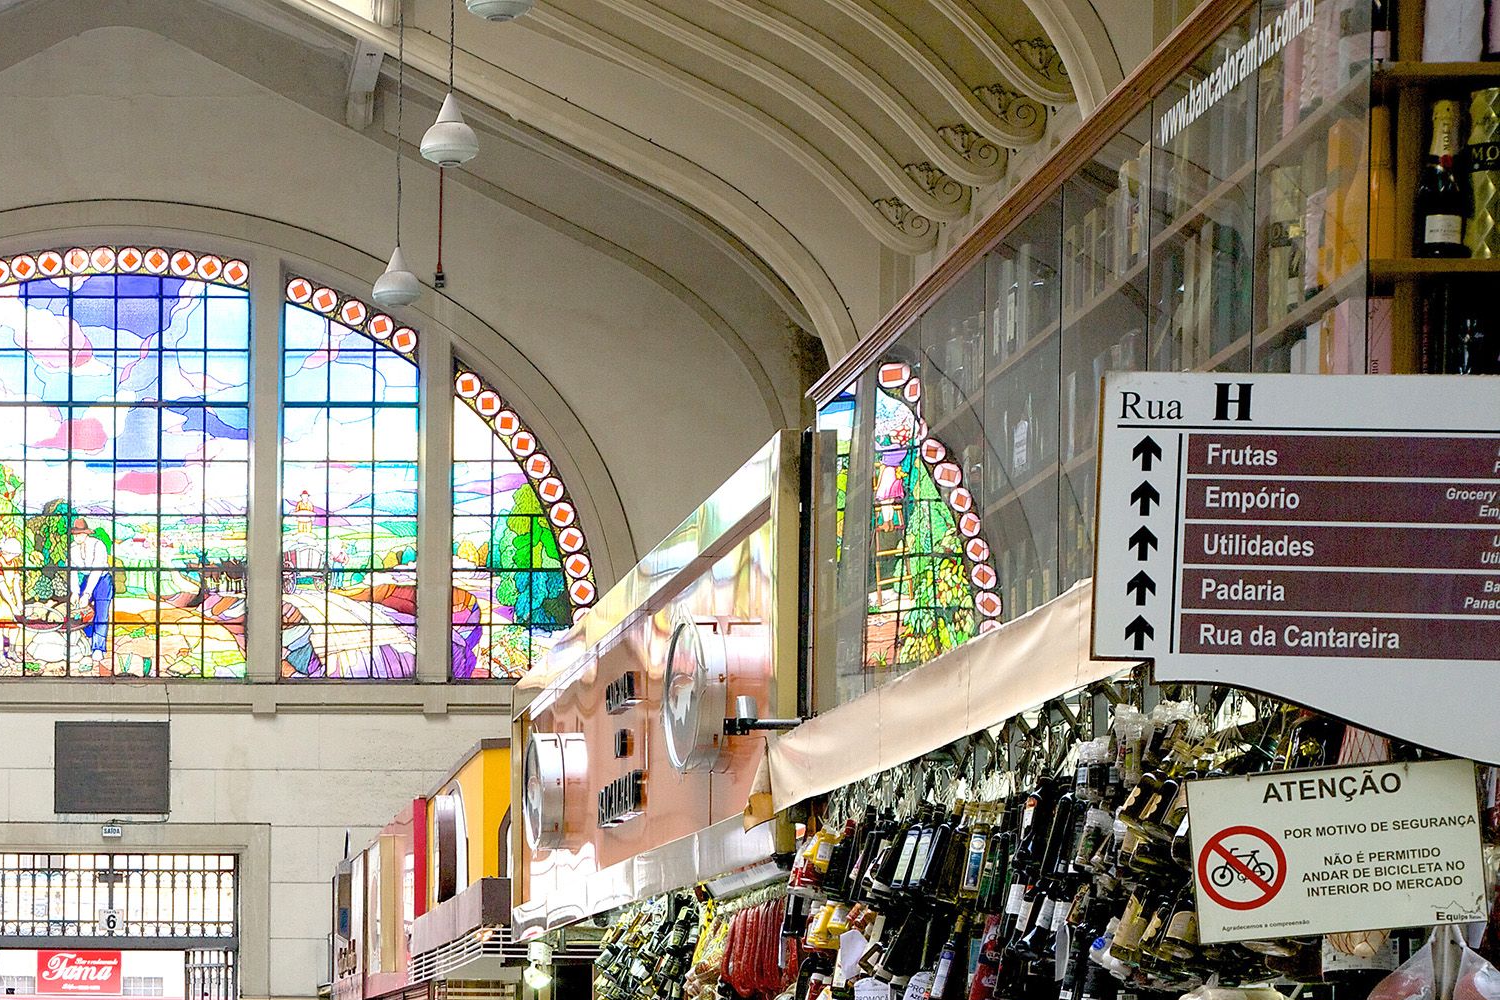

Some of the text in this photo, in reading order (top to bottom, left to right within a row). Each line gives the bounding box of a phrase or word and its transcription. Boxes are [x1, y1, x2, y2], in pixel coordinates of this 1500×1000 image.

[1119, 383, 1254, 421] Rua H
[1207, 444, 1278, 466] Frutas
[1205, 486, 1300, 512] Empório
[1446, 488, 1496, 502] Grocery
[1203, 534, 1315, 557] Utilidades
[1201, 579, 1285, 602] Padaria
[1199, 623, 1400, 649] Rua da Cantareira
[1262, 770, 1402, 803] ATENÇÃO
[1284, 815, 1476, 840] POR MOTIVO DE SEGURANÇA
[1324, 847, 1441, 866] NÃO É PERMITIDO
[1302, 860, 1465, 883] ANDAR DE BICICLETA NO
[1307, 875, 1463, 897] INTERIOR DO MERCADO
[106, 915, 116, 929] 6
[1222, 924, 1262, 932] Agradecemos
[42, 953, 113, 981] Fama
